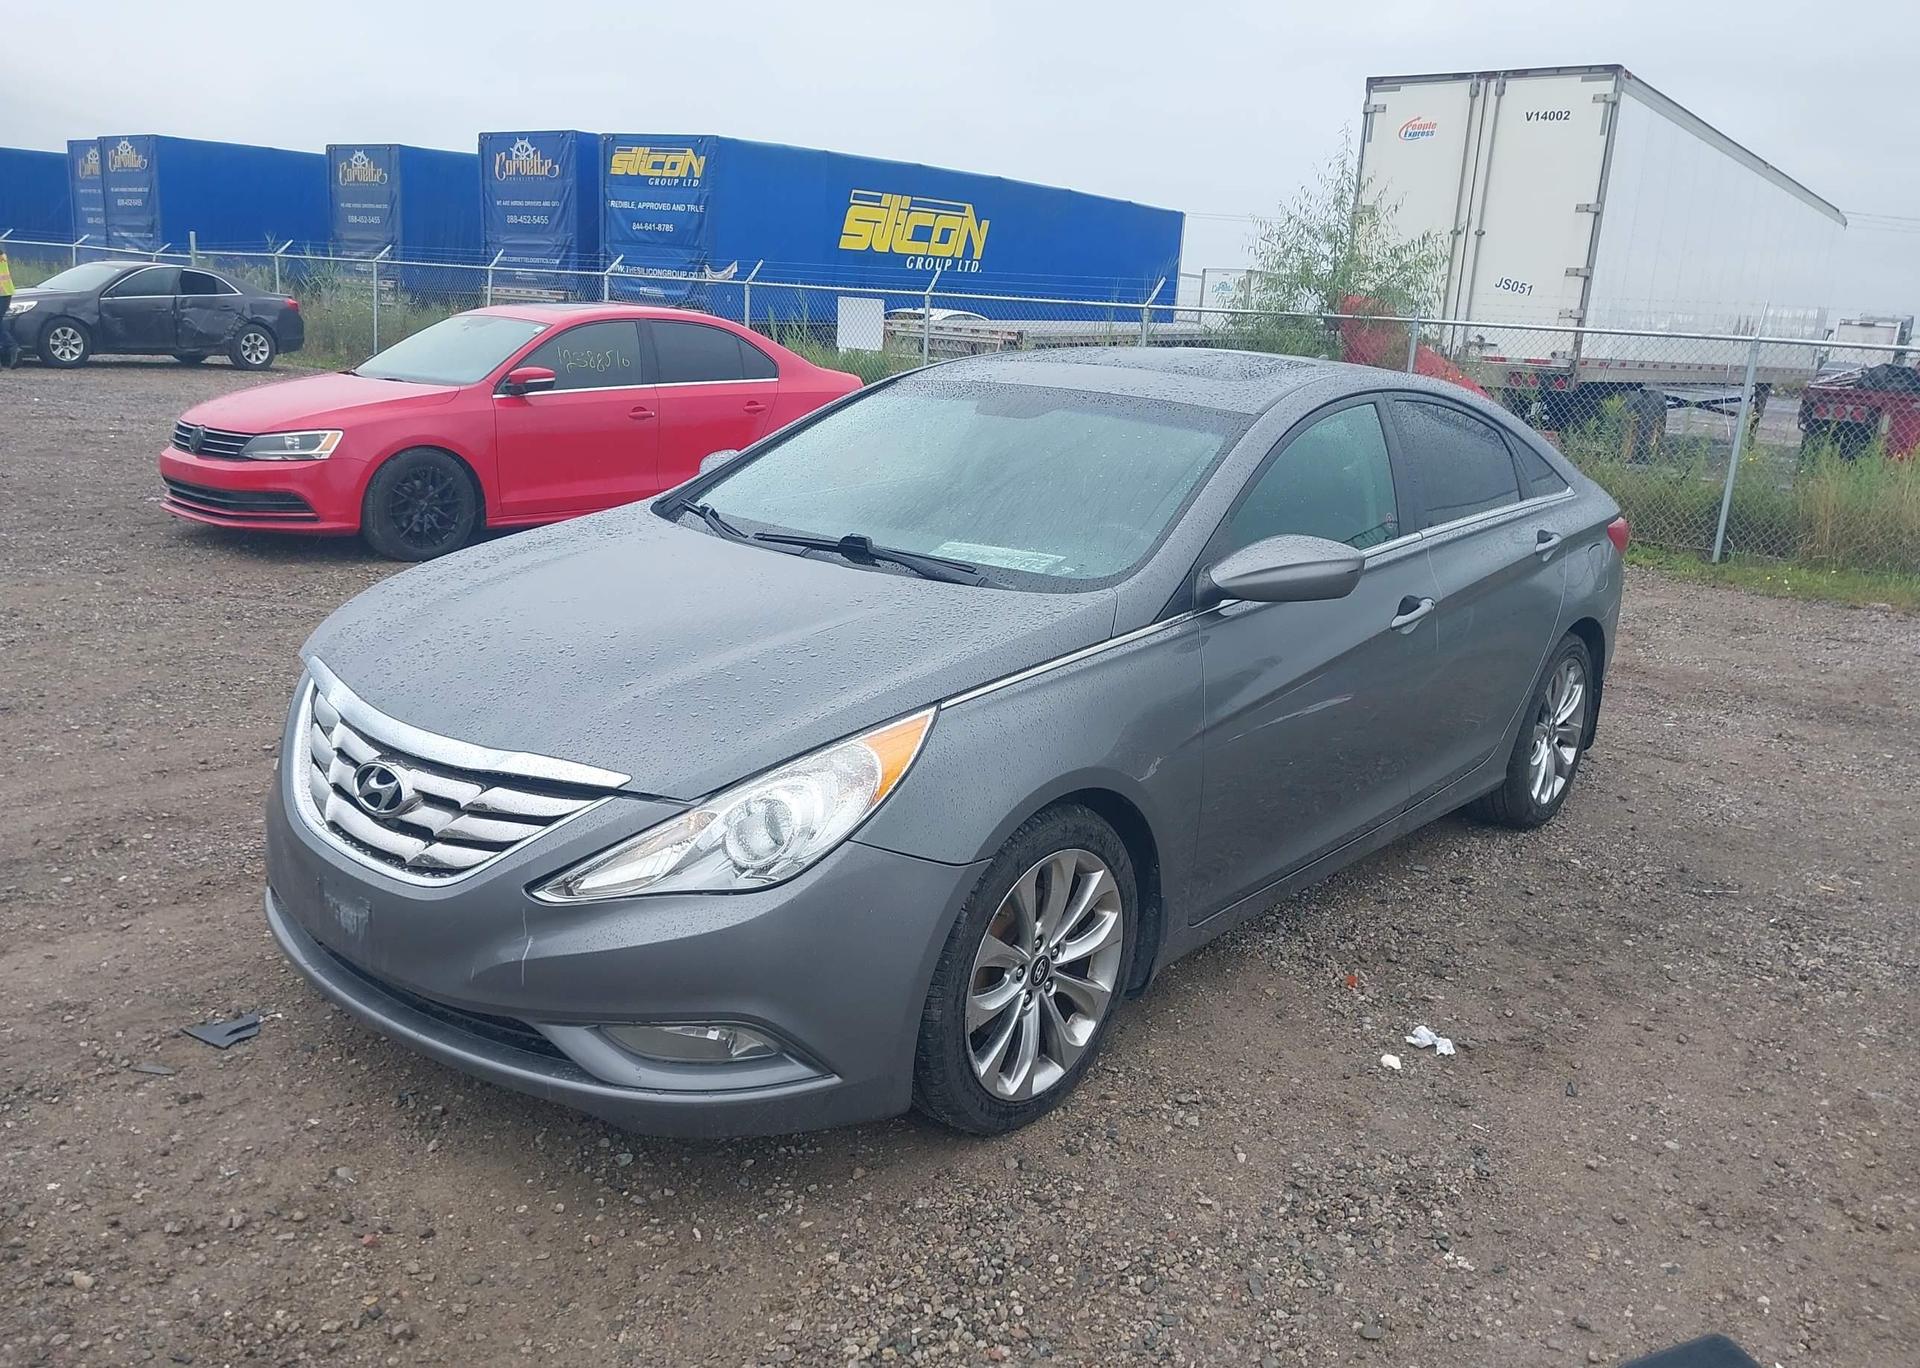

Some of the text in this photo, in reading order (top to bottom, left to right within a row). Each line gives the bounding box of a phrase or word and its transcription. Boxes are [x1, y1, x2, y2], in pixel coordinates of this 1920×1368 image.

[1525, 110, 1571, 122] V14002
[1403, 129, 1435, 138] Express
[495, 149, 560, 181] Corvette
[339, 160, 388, 186] Corvette
[648, 178, 679, 187] GROUP
[638, 201, 671, 211] APPROVED
[672, 204, 686, 212] AND
[506, 215, 549, 225] 888-452-5455
[632, 222, 674, 233] 844-641-8785
[906, 255, 984, 273] GROUP LTD.
[1494, 276, 1534, 296] JS051
